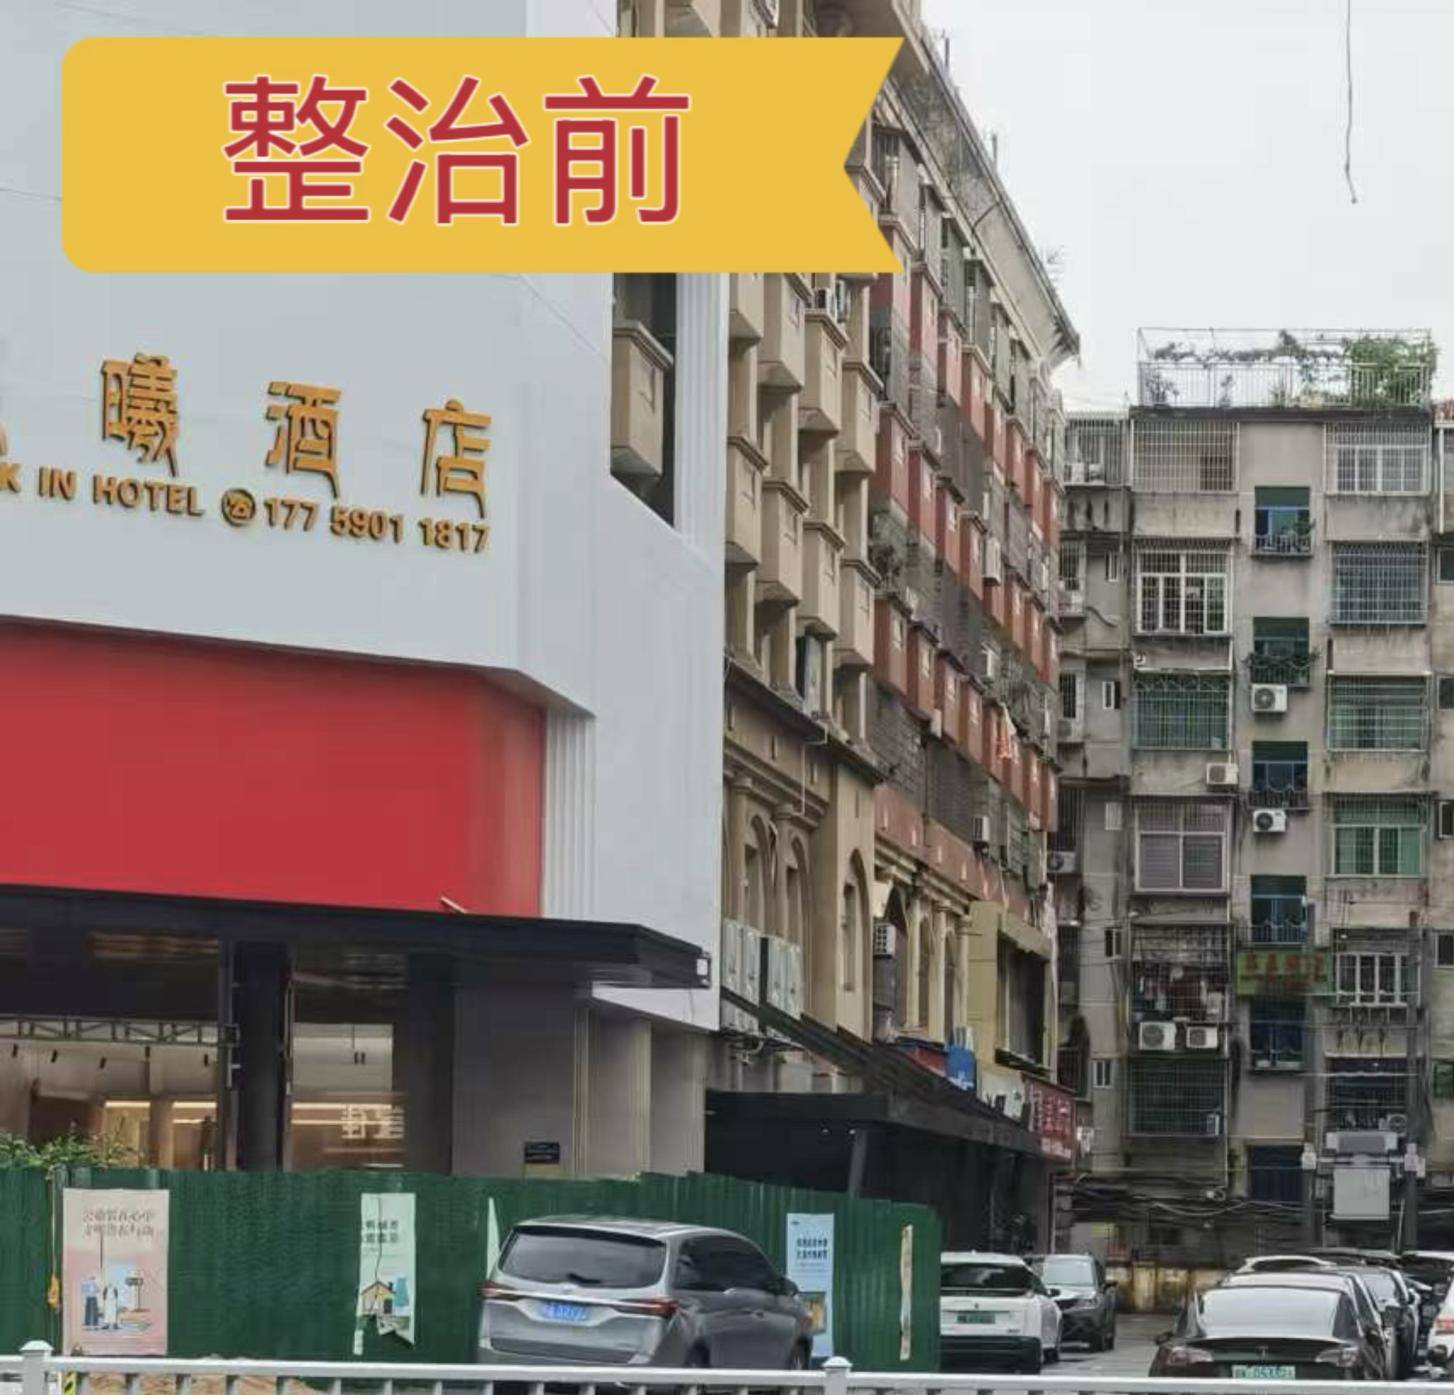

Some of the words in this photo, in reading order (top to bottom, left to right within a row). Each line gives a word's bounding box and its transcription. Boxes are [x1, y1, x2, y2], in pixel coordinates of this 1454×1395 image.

[0, 352, 492, 518] 曦酒店
[38, 466, 76, 500] IN
[92, 474, 205, 516] HOTEL
[264, 496, 316, 532] 177
[330, 505, 404, 543] 5901
[419, 516, 491, 554] 1817
